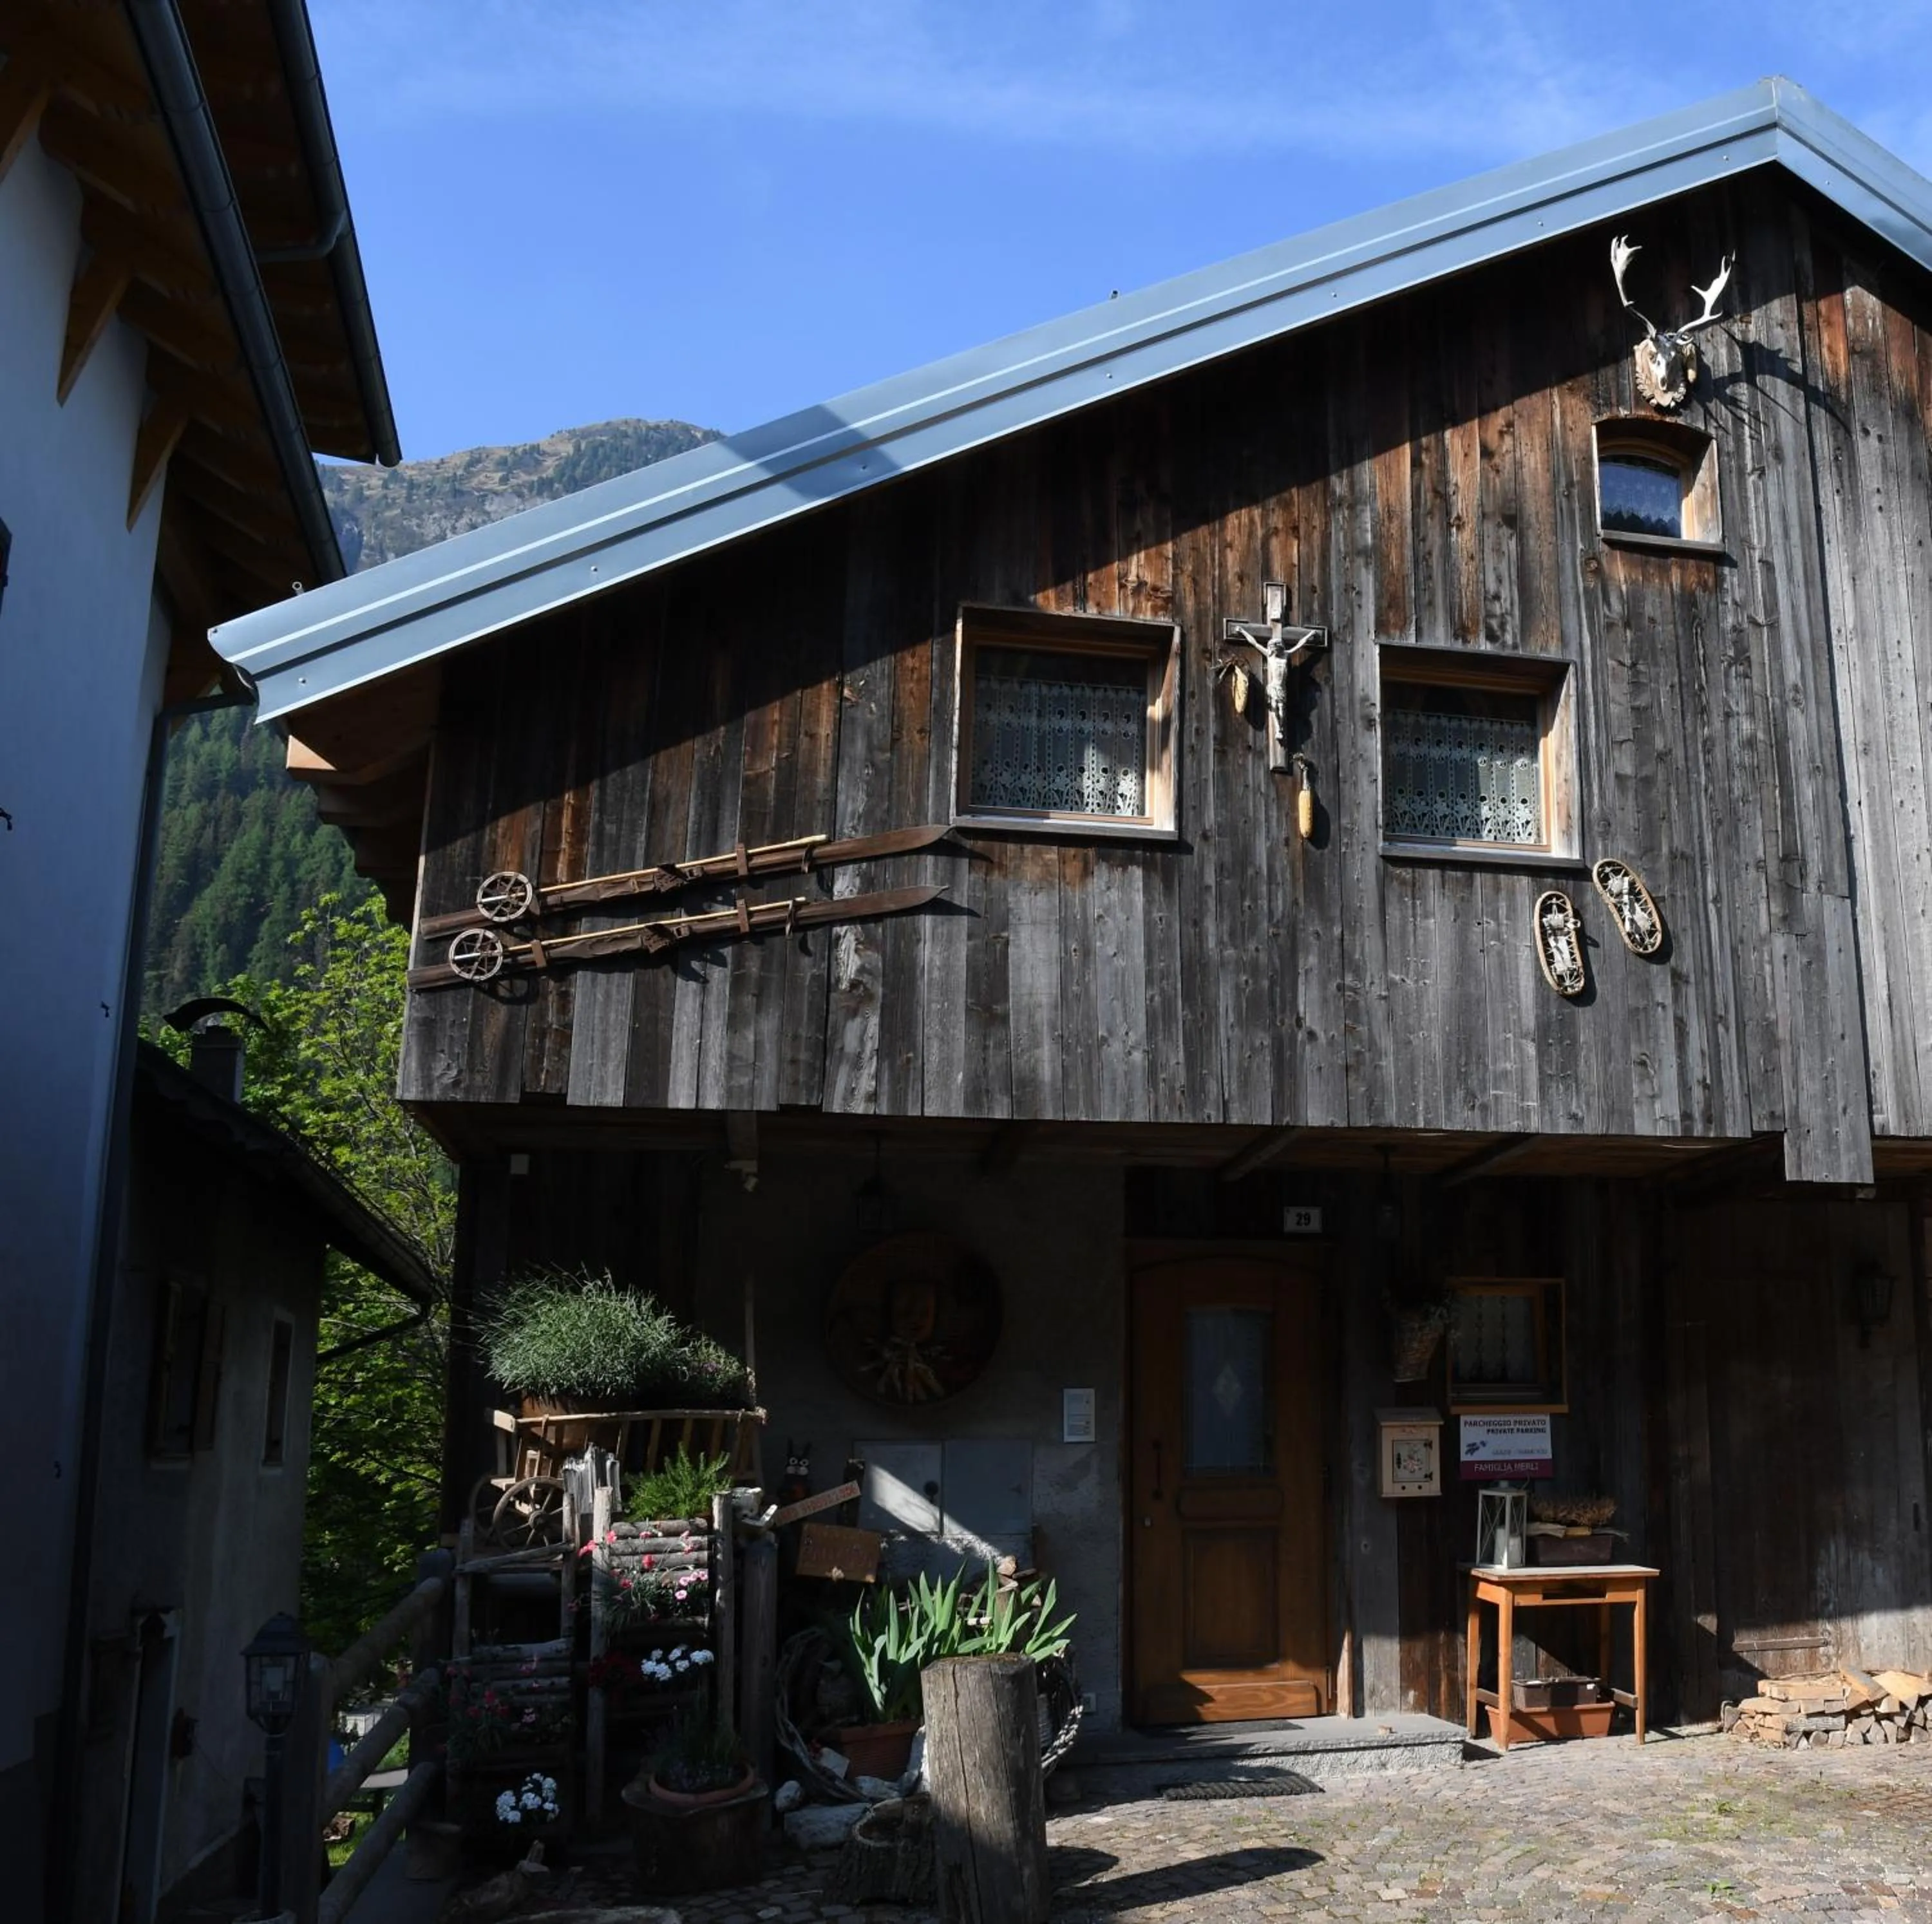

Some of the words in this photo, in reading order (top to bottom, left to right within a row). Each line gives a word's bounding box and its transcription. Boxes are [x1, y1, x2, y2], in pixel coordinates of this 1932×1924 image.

[1296, 1212, 1311, 1227] 29
[1474, 1463, 1513, 1472] FAMIGLIA
[1514, 1462, 1539, 1471] MERLI
